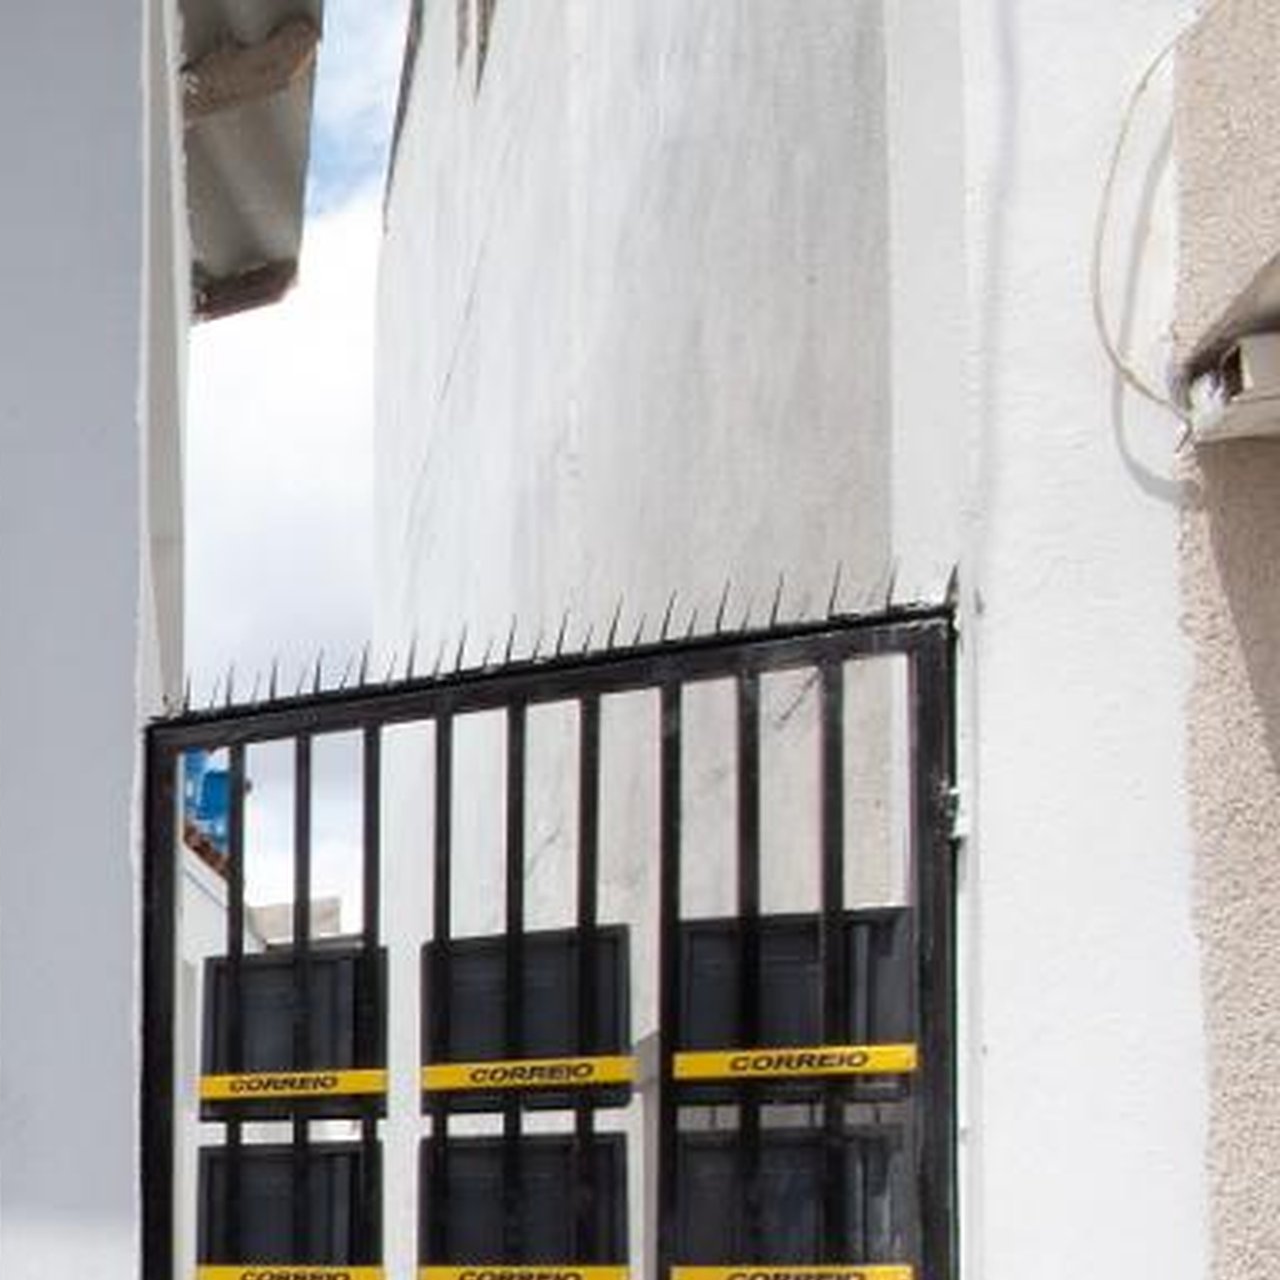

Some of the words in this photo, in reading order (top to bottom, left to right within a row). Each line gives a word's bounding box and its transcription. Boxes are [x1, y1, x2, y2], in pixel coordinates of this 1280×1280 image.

[729, 1050, 869, 1072] CORREIO
[229, 1074, 339, 1093] CORREIO
[469, 1062, 594, 1084] CORREIO
